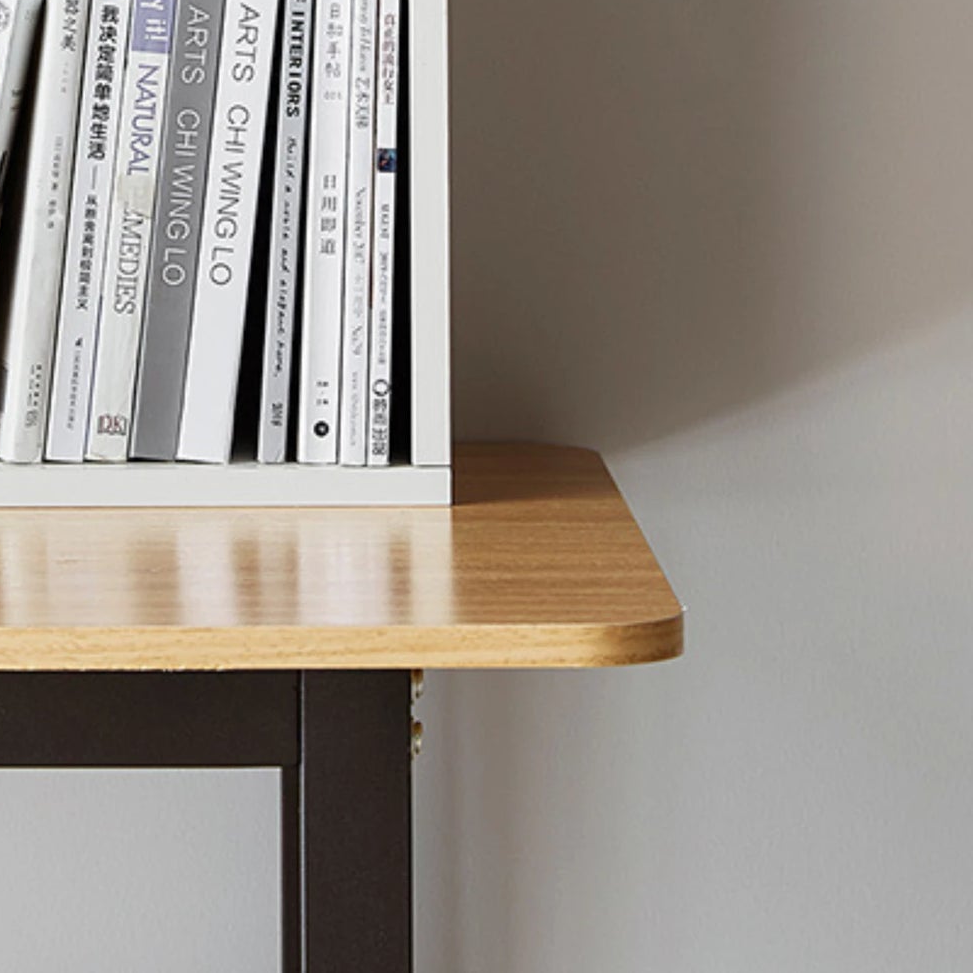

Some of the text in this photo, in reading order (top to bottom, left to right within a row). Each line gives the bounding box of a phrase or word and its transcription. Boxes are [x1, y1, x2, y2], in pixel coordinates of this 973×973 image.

[144, 15, 168, 41] it!
[162, 4, 211, 286] ARTS CHI WING LO
[209, 2, 261, 286] ARTS CHI WING LO
[286, 11, 305, 119] INTERIORS
[114, 63, 161, 314] NATURAL MEDIES
